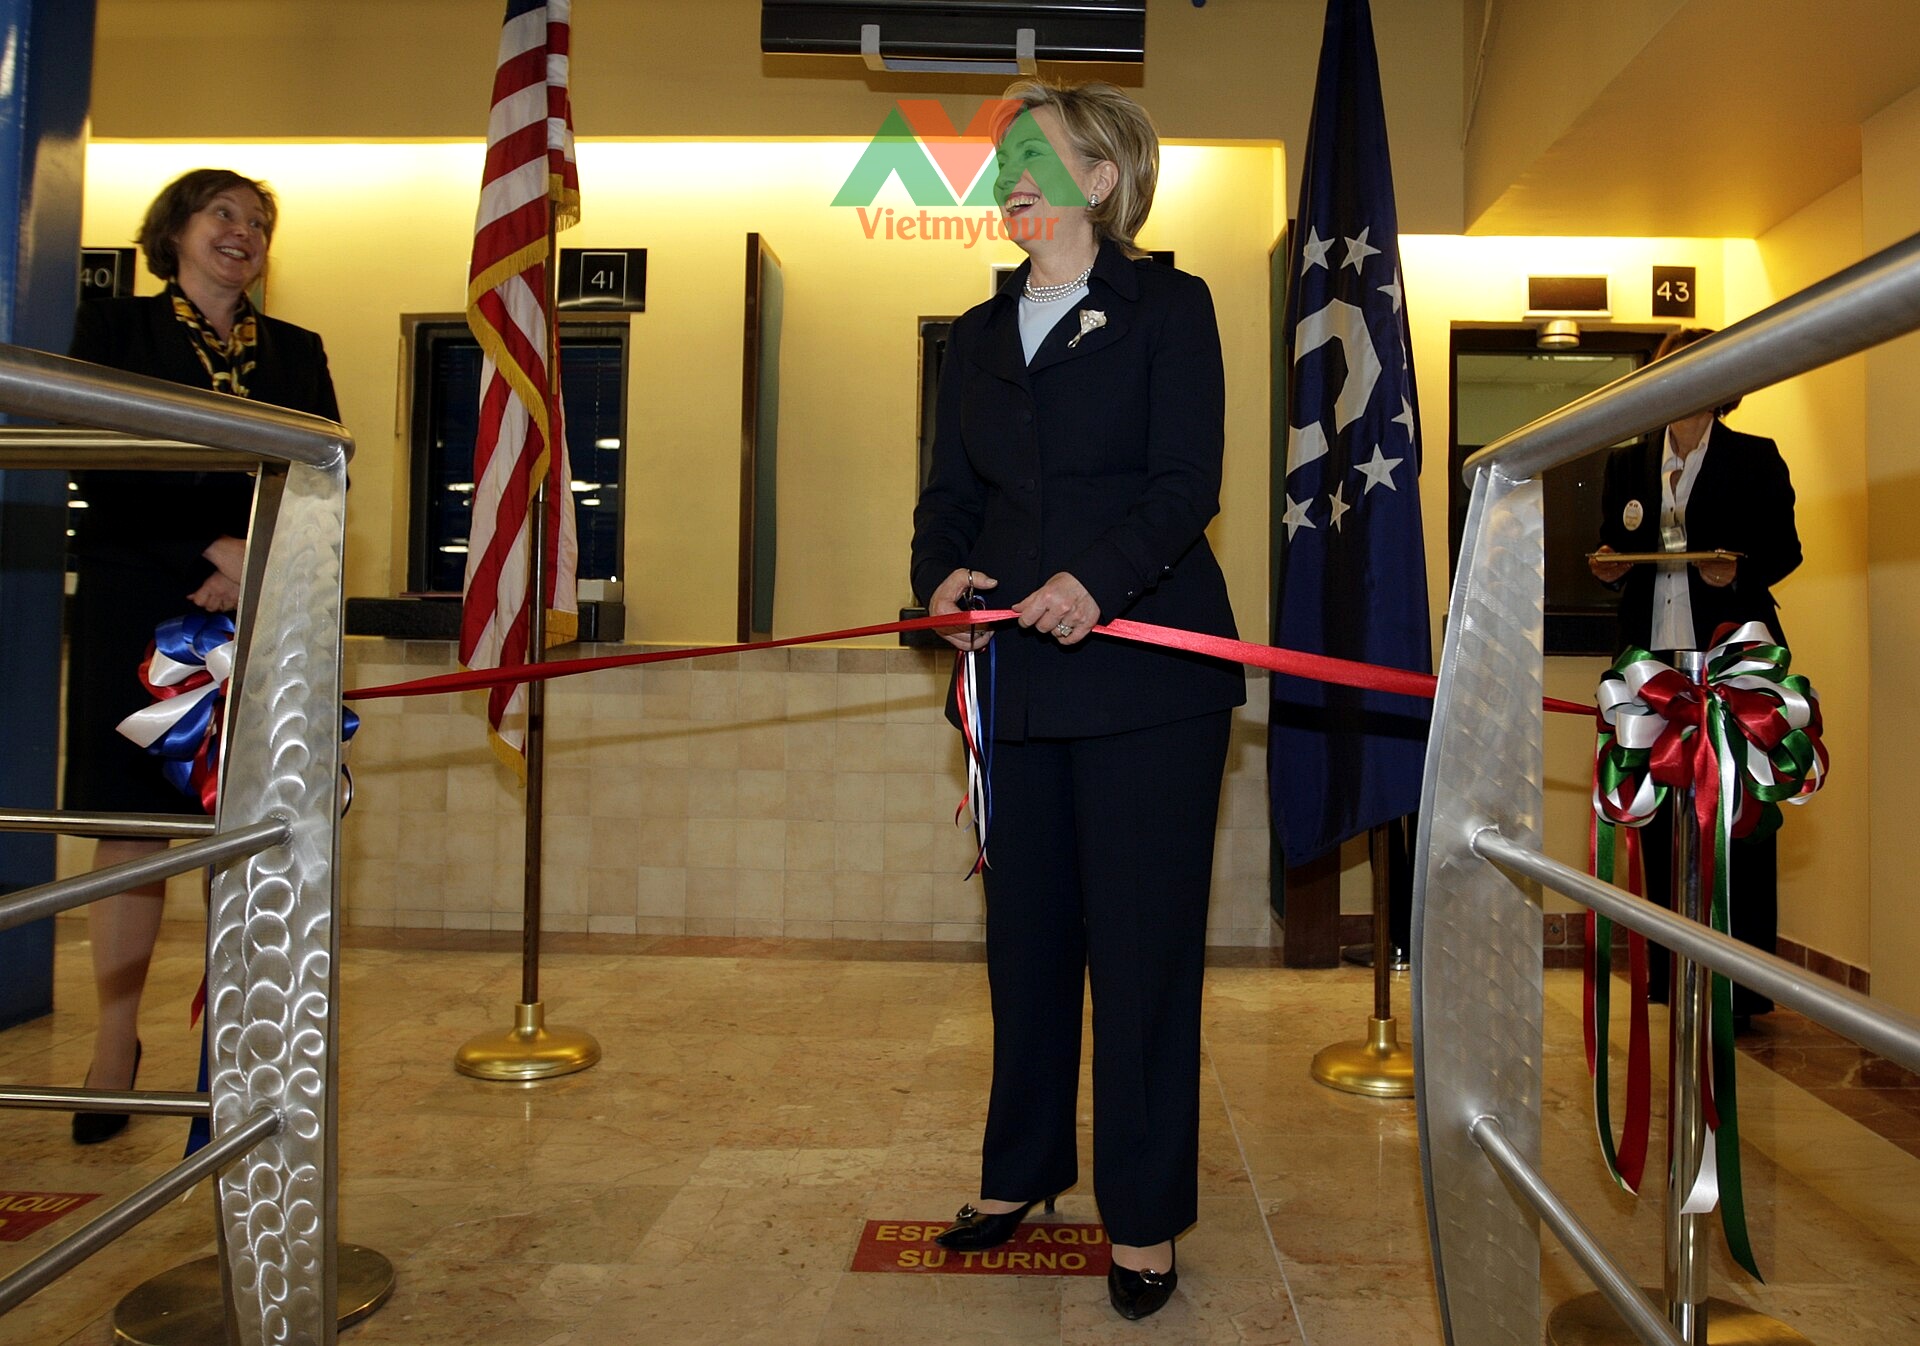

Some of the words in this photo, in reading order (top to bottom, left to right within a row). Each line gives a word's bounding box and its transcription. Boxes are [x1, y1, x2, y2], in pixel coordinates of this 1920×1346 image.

[591, 270, 614, 289] 41
[1656, 281, 1690, 302] 43
[1027, 1228, 1112, 1244] AQU
[896, 1250, 947, 1268] SU
[959, 1252, 1087, 1270] TURNO
